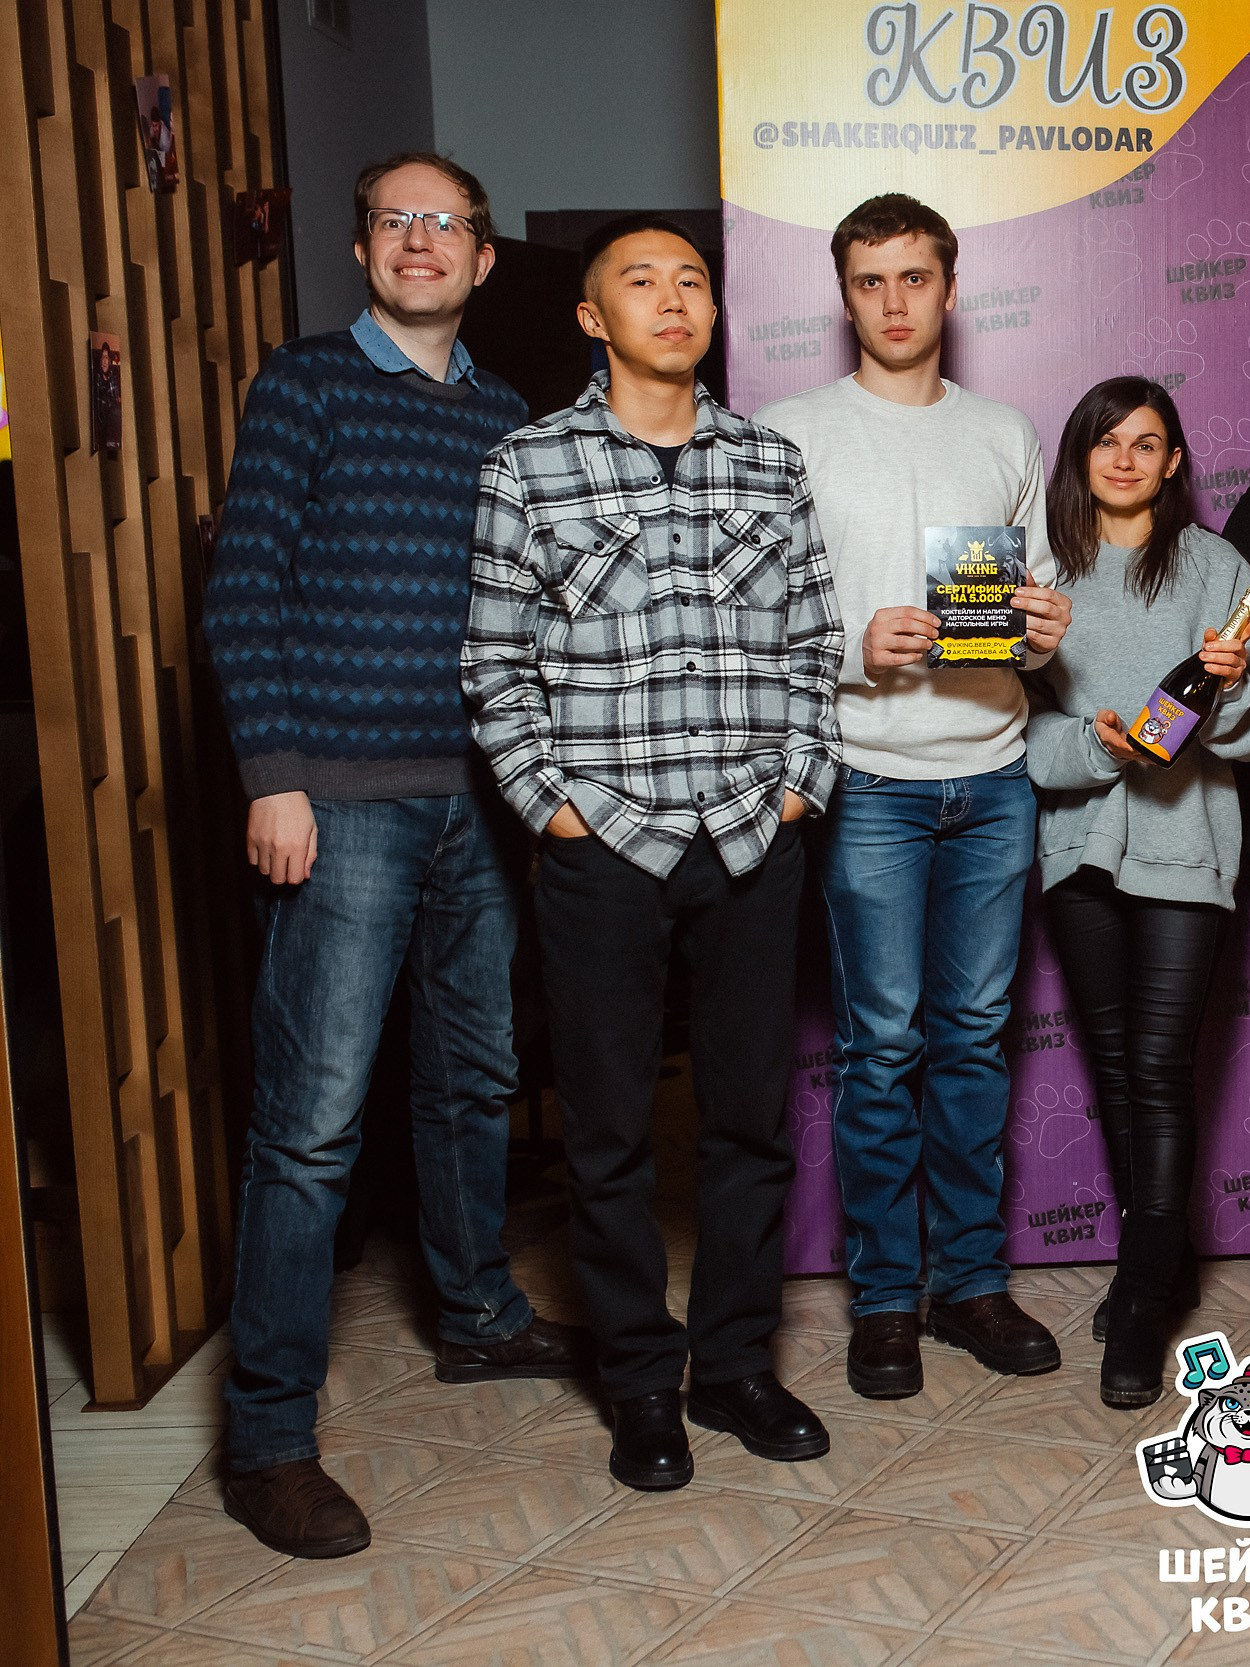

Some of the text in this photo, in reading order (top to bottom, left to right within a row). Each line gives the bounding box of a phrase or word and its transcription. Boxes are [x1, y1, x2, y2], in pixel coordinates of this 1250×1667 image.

[753, 121, 1154, 155] @SHAKERQUIZ_PAVLODAR
[1089, 188, 1144, 209] КВИЗ
[1166, 257, 1247, 284] ШЕЙКЕР
[959, 285, 1042, 312] ШЕЙКЕР
[1180, 283, 1236, 304] КВИЗ
[750, 315, 833, 342] ШЕЙКЕР
[975, 311, 1031, 333] КВИЗ
[764, 340, 822, 363] КВИЗ
[1211, 492, 1243, 511] КВ
[955, 563, 998, 575] VIKING
[936, 584, 1016, 595] СЕРТИФИКАТ
[950, 593, 1003, 603] НА 5.000
[1157, 706, 1176, 721] КВИЗ
[1158, 697, 1185, 717] ШЕЙКЕР
[1024, 1031, 1066, 1053] ВИЗ
[1028, 1201, 1106, 1228] ШЕЙКЕР
[1043, 1225, 1096, 1247] КВИЗ
